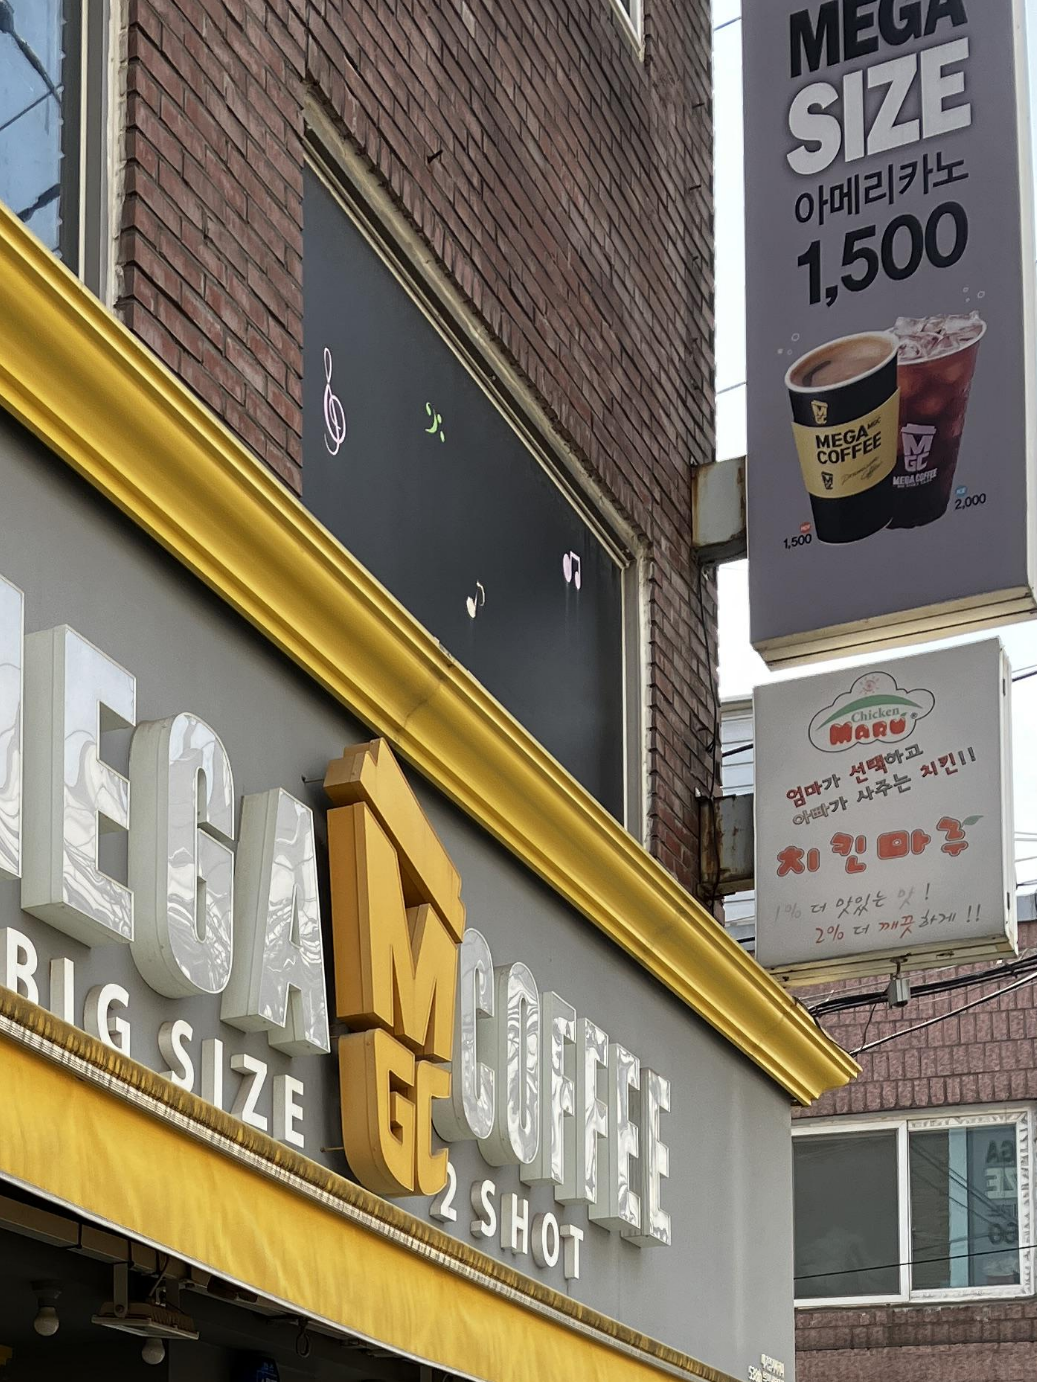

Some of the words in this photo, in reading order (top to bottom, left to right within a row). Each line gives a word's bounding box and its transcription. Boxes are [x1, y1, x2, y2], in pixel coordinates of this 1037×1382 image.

[786, 37, 971, 176] SIZE
[794, 153, 969, 226] 아메리카노
[797, 201, 968, 308] 1,500
[815, 425, 869, 449] MEGA
[817, 431, 882, 464] COFFEE
[954, 493, 987, 510] 2,000
[783, 533, 812, 550] 1,500
[851, 706, 900, 724] Chicken
[786, 774, 841, 808] 엄마가
[849, 744, 924, 784] 선택하고
[792, 796, 848, 826] 아빠가
[857, 773, 912, 803] 사주는
[810, 901, 827, 914] 더
[835, 890, 888, 919] 맛있는
[815, 923, 845, 944] 2%
[853, 921, 869, 935] 더
[159, 1018, 306, 1150] SIZE
[434, 928, 672, 1248] COFFEE
[430, 1161, 457, 1223] 2
[470, 1179, 585, 1280] SHOT
